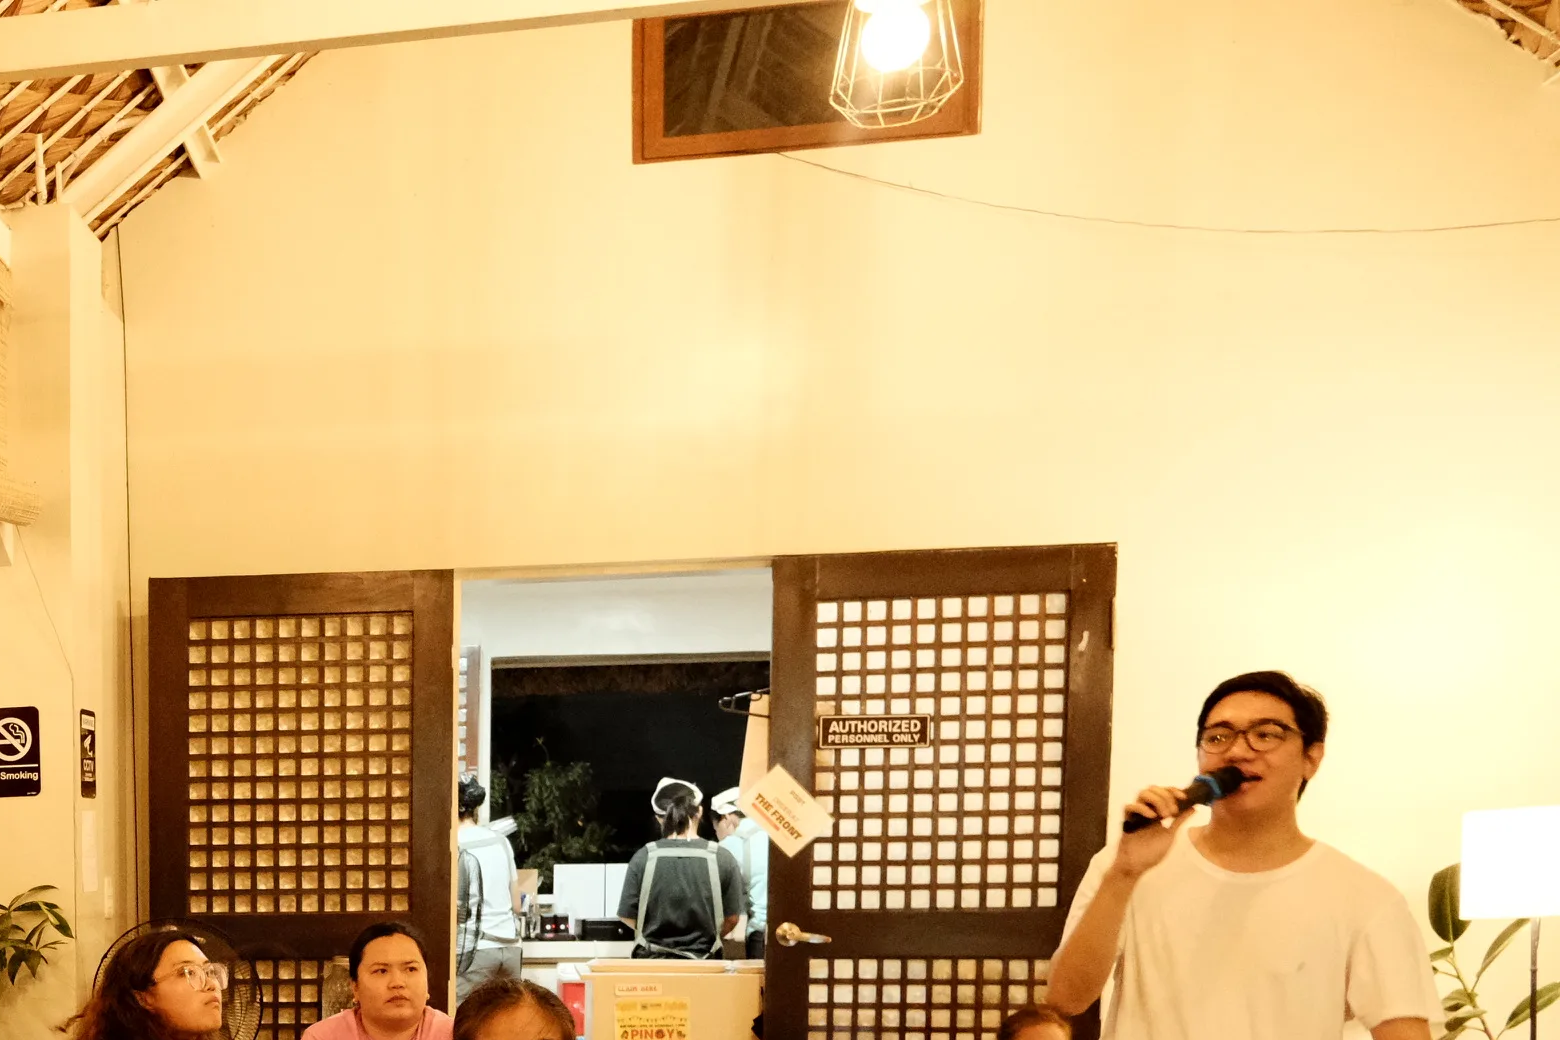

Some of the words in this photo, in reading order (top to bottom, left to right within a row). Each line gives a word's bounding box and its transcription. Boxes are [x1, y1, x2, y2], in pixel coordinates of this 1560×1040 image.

[828, 719, 922, 733] AUTHORIZED
[828, 734, 890, 744] PERSONNEL
[892, 733, 920, 743] ONLY
[0, 770, 39, 781] Smoking
[755, 792, 774, 812] THE
[771, 809, 803, 840] FRONT
[631, 1028, 674, 1039] PINOY
